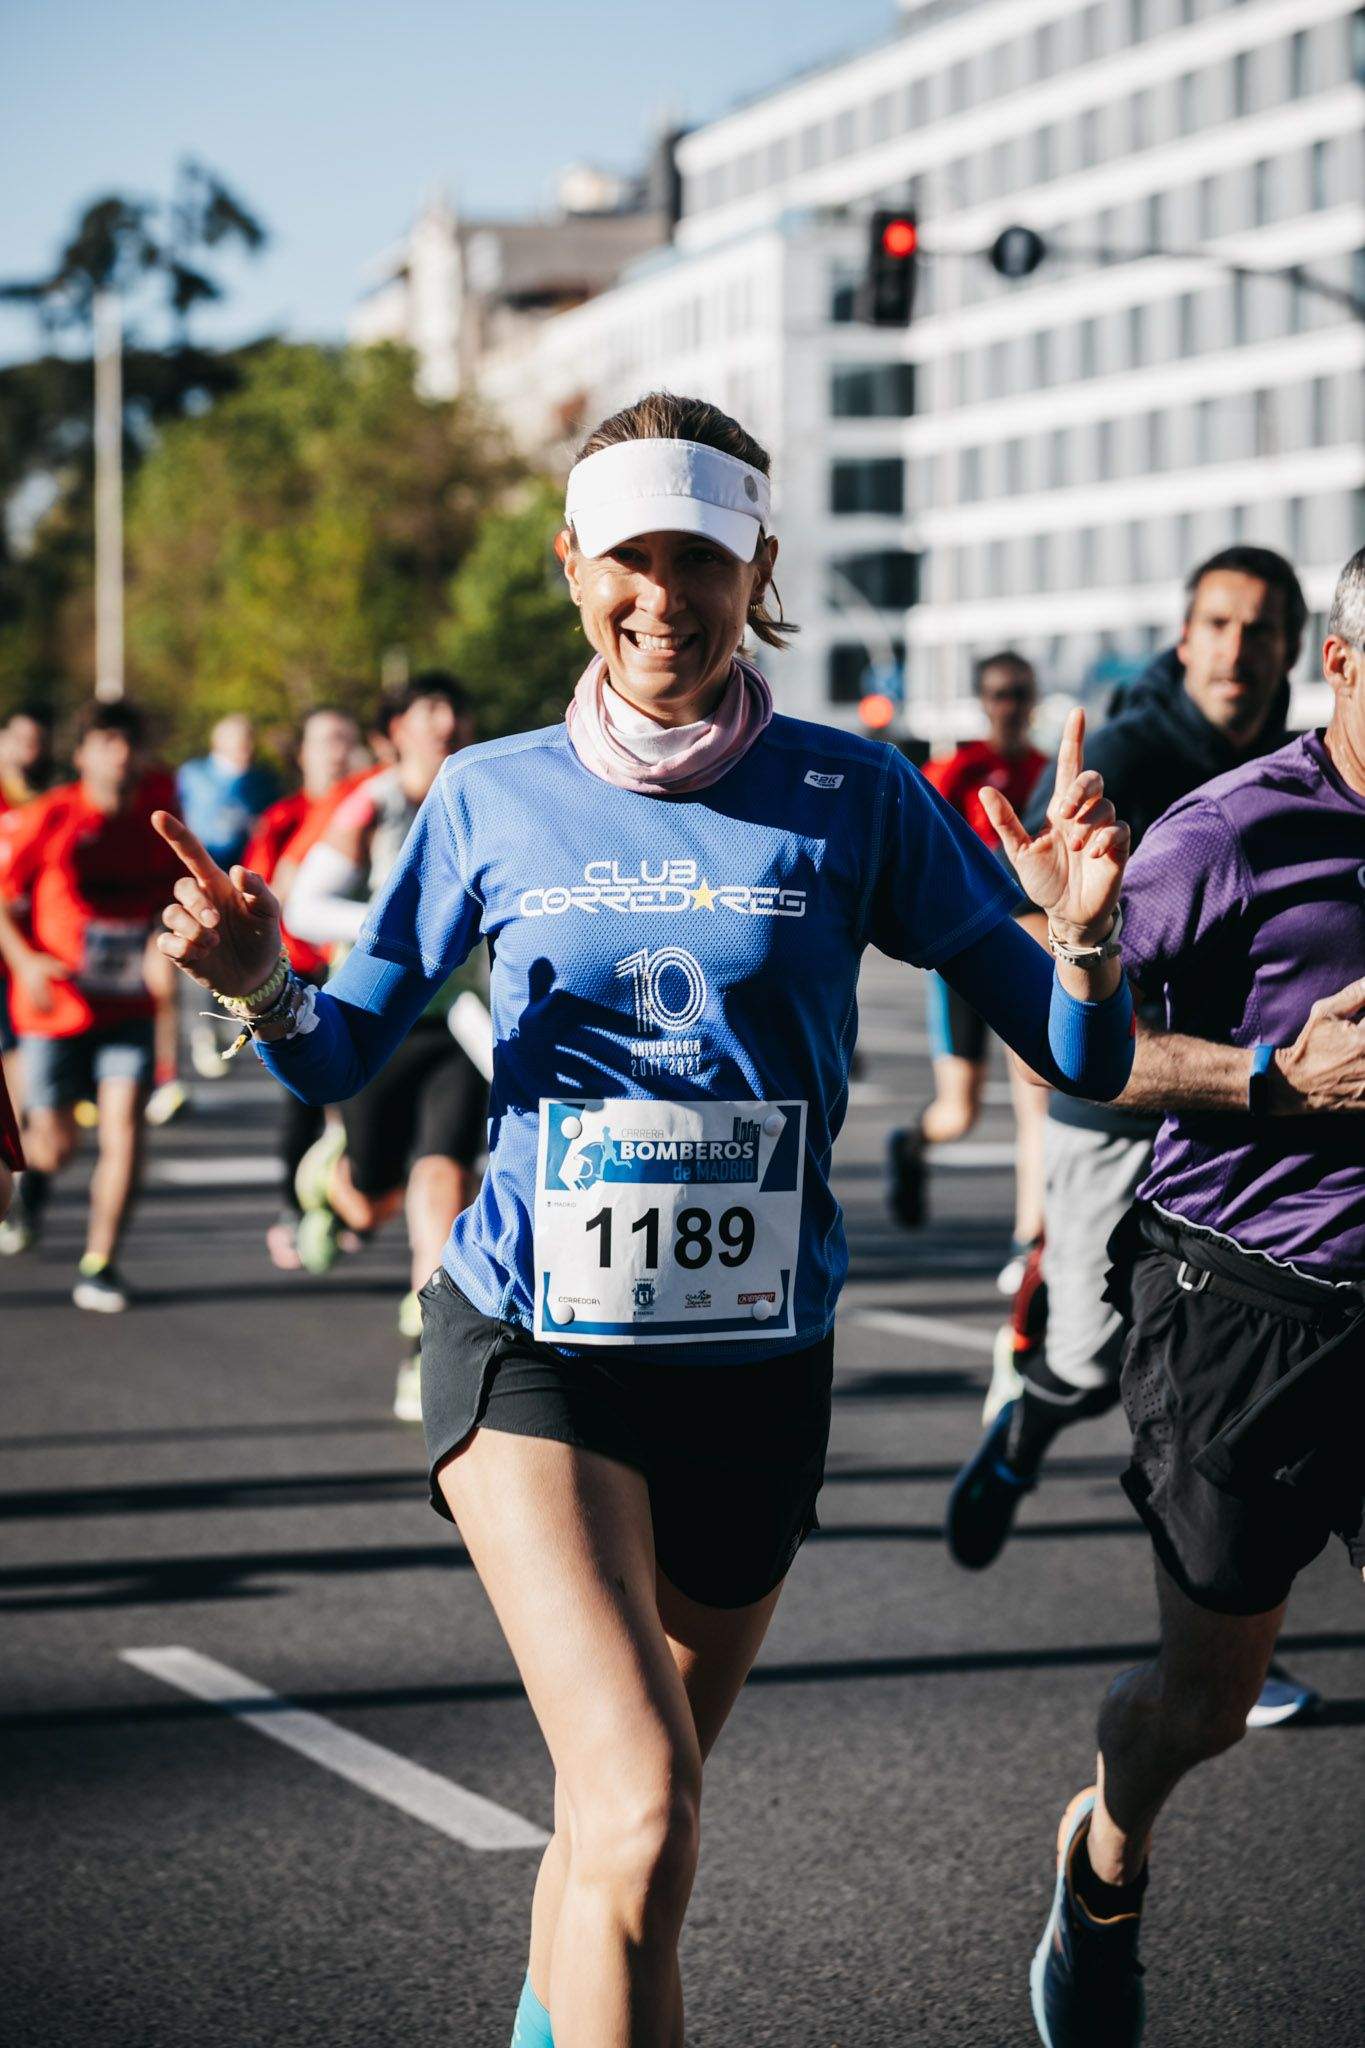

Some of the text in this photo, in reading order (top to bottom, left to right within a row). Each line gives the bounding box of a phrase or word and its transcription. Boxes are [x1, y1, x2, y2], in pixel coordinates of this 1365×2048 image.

[584, 860, 696, 883] CLUB
[614, 947, 707, 1032] 10
[621, 1128, 664, 1139] CARRERA
[620, 1141, 754, 1160] BOMBEROS
[673, 1160, 754, 1181] de MADRID
[585, 1206, 755, 1270] 1189
